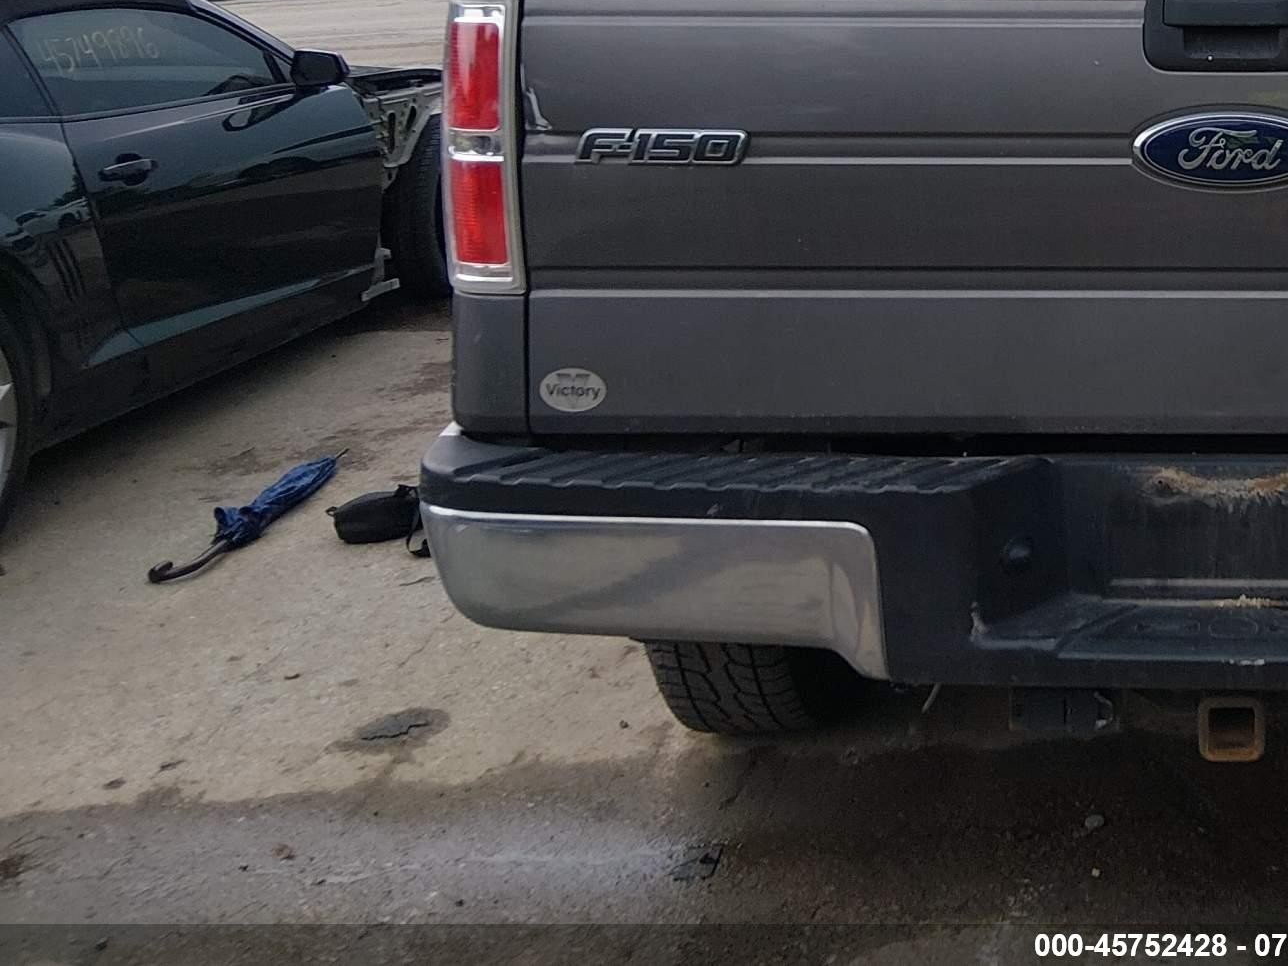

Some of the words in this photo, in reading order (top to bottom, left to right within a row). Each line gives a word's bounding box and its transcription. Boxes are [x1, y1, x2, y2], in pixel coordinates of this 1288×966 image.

[574, 128, 749, 165] F-150
[1177, 127, 1283, 170] Ford
[545, 383, 601, 401] Victory
